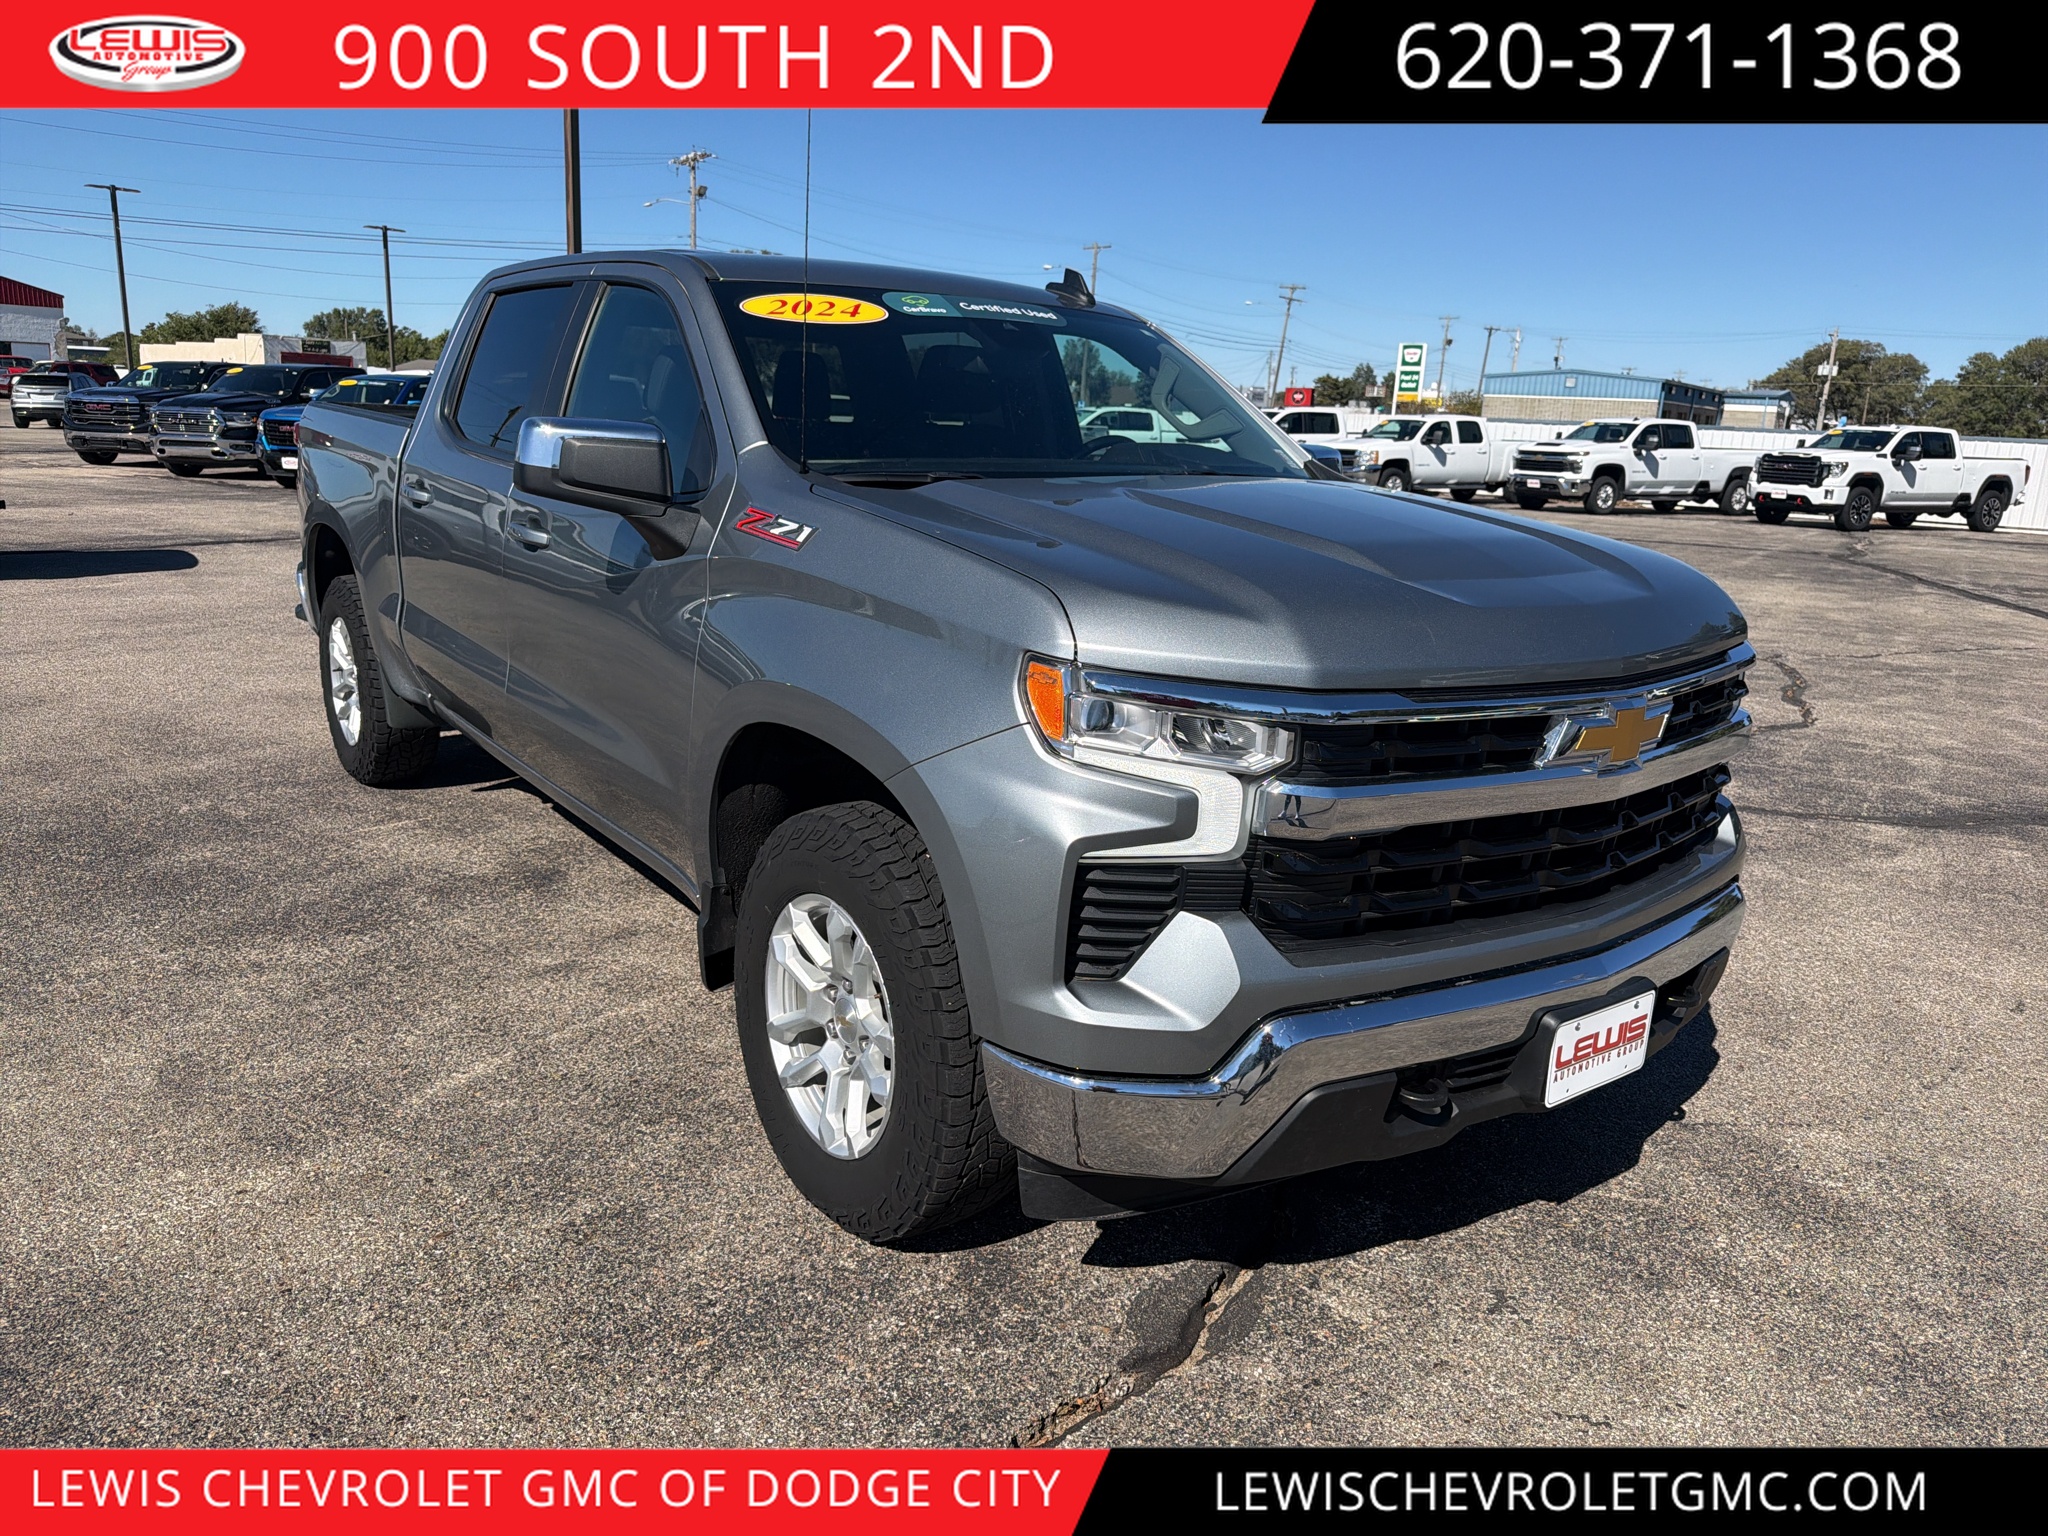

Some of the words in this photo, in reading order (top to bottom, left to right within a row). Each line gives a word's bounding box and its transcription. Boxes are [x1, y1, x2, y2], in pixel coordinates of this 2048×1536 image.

[764, 299, 862, 319] 2024
[902, 305, 947, 314] CarBravo
[958, 301, 1022, 316] Certified
[1021, 308, 1058, 320] Used
[85, 403, 112, 411] GMC
[735, 507, 813, 550] Z71
[1554, 1013, 1649, 1070] LEWIS
[1552, 1053, 1612, 1084] AUTOMOTIVE
[1616, 1038, 1645, 1059] GROUP
